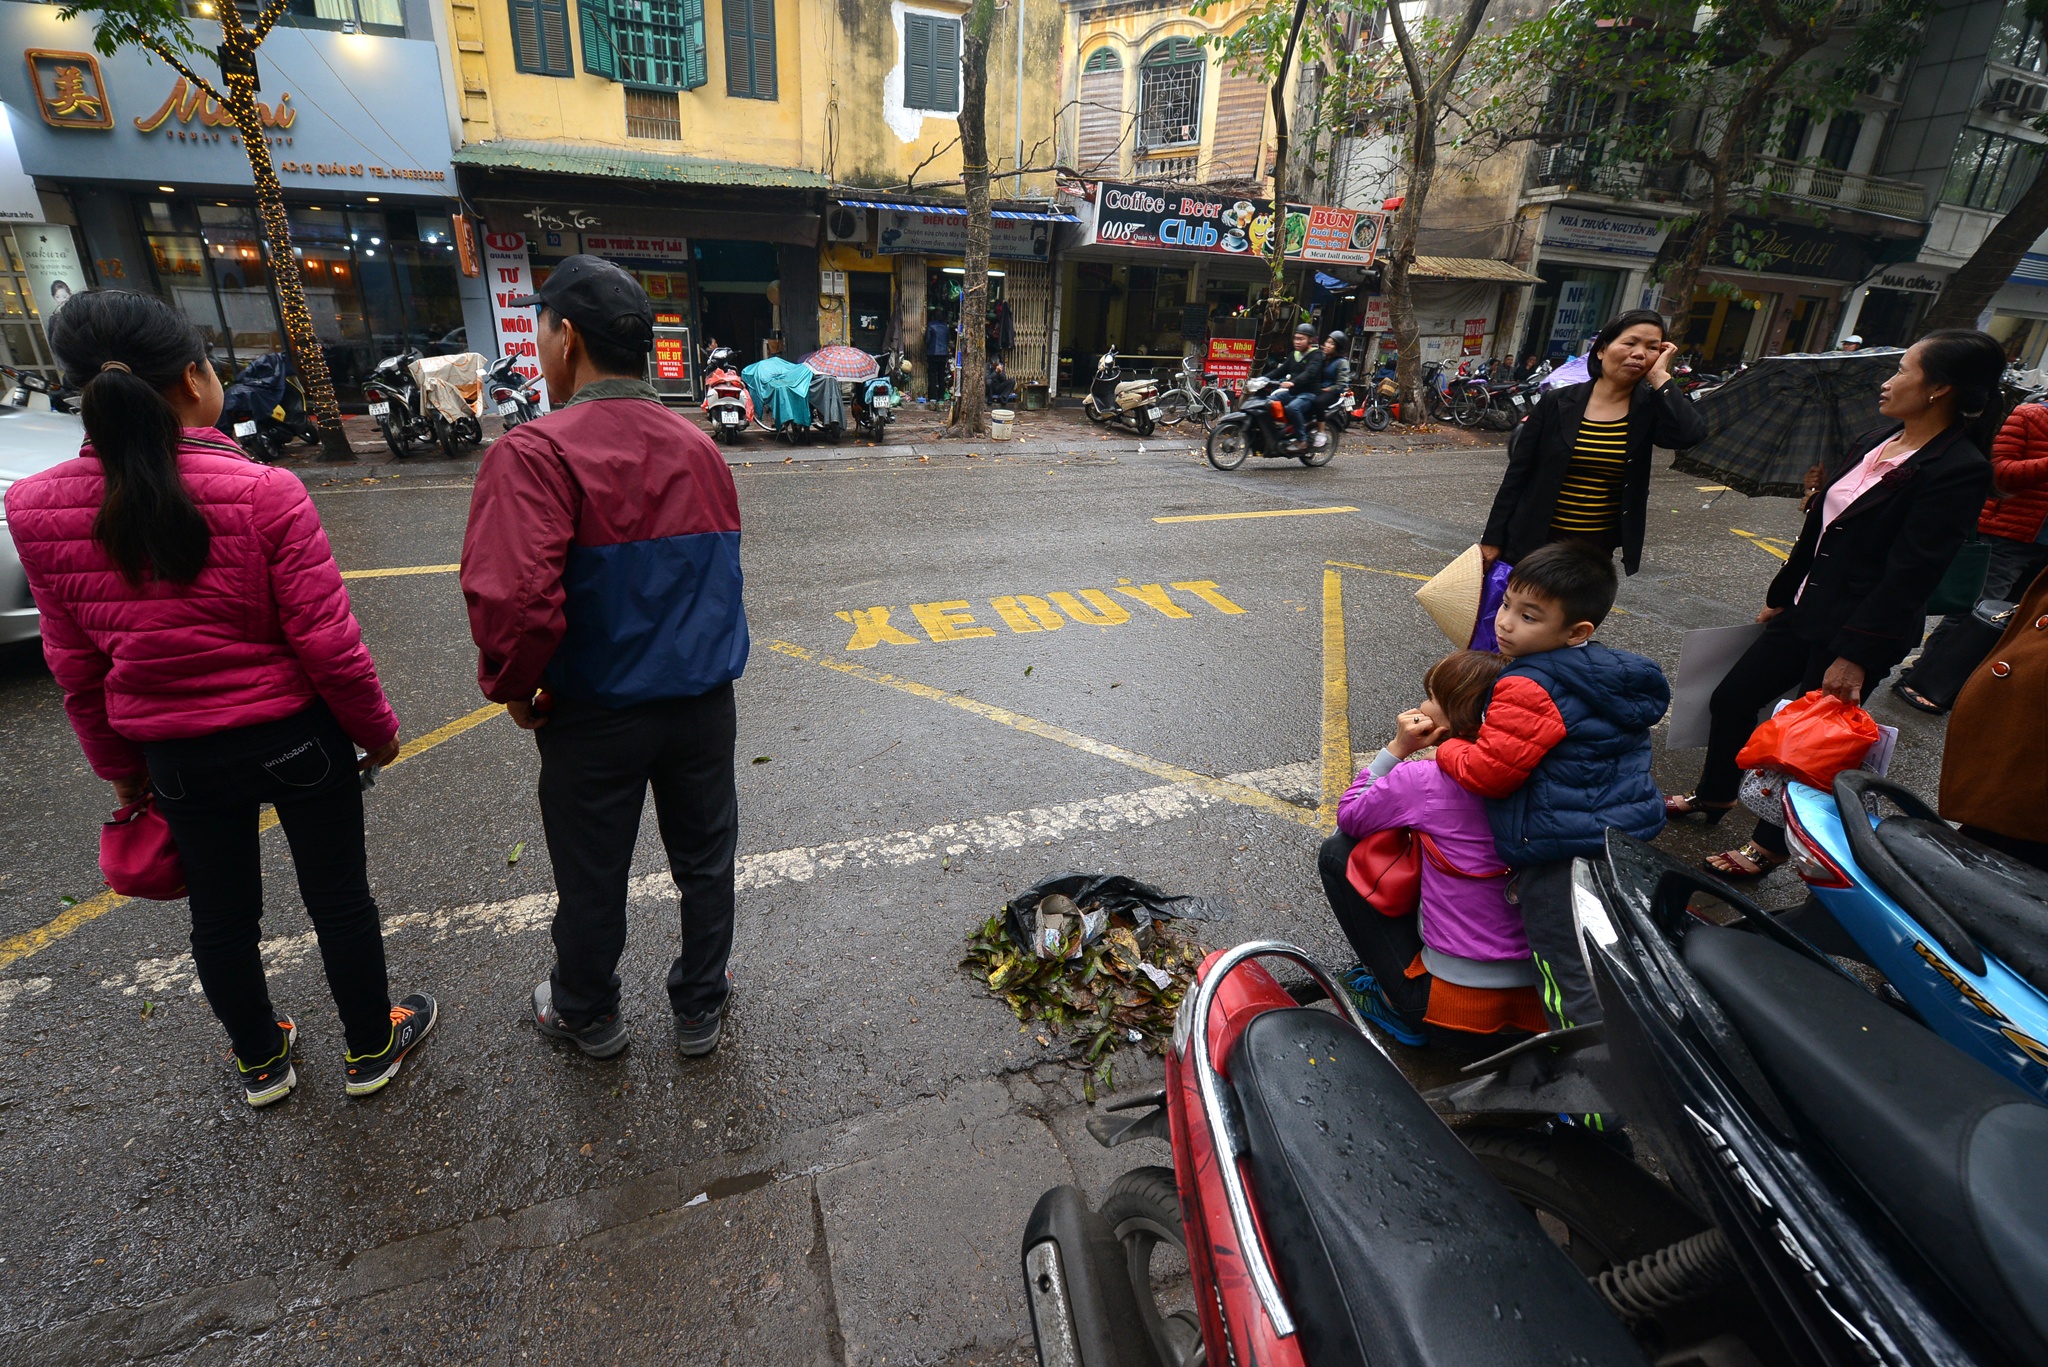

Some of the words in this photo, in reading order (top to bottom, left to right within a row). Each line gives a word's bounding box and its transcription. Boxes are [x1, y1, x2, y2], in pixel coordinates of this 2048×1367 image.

[45, 66, 101, 117] 美
[166, 129, 220, 142] TRULY
[230, 134, 294, 146] BUTY
[1106, 189, 1166, 213] Coffee
[1179, 197, 1222, 218] Beer
[1313, 209, 1354, 228] BÚN
[1101, 220, 1133, 241] 008
[1159, 218, 1219, 247] Club
[494, 234, 518, 248] 10
[25, 246, 67, 258] sakura
[1327, 251, 1341, 259] ball
[1341, 252, 1364, 261] noodle
[96, 258, 126, 278] 12
[497, 266, 520, 283] TƯ
[501, 315, 533, 333] MÔI
[672, 351, 682, 360] ĐT
[1913, 939, 2003, 1019] WAVE
